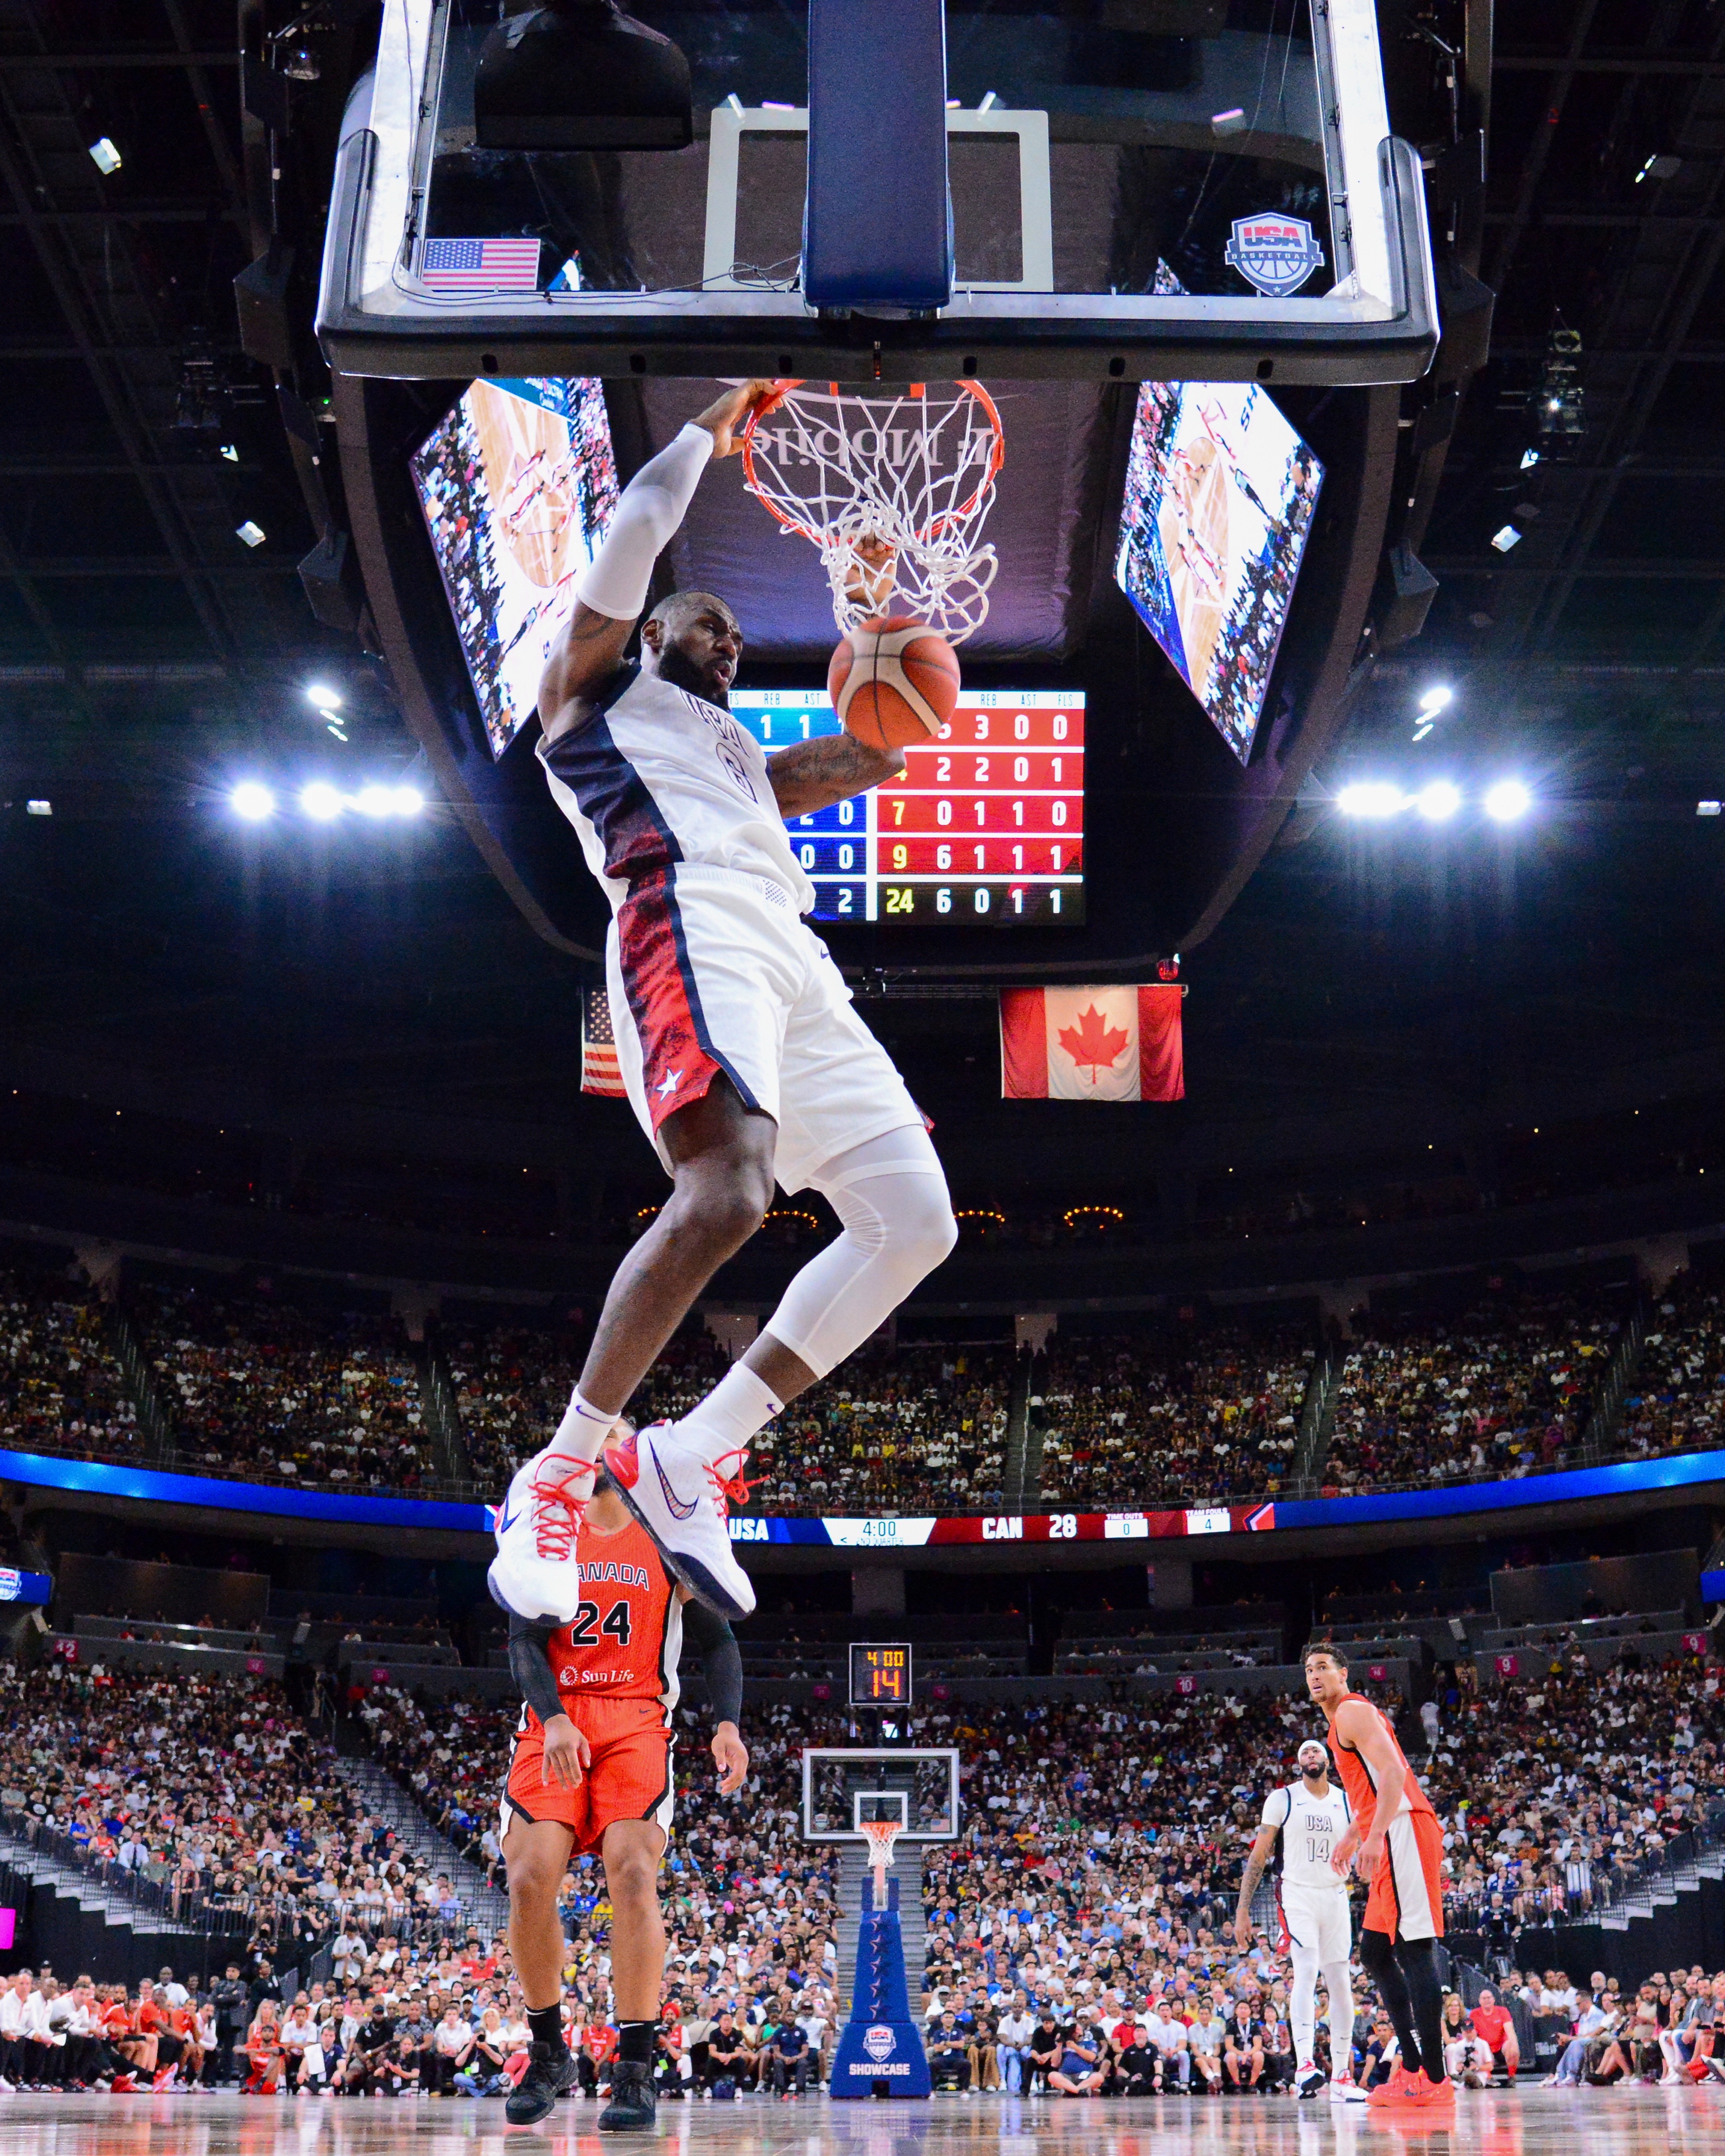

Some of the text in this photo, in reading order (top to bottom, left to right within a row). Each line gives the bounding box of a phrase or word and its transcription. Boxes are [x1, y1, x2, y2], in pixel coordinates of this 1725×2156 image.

[1243, 226, 1303, 248] USA
[1231, 253, 1316, 261] BASKETBALL
[730, 693, 820, 705] TS REB AST
[981, 694, 1072, 706] REB AST FLS
[679, 686, 750, 758] USA
[761, 714, 771, 739] 1
[799, 714, 810, 739] 1
[975, 715, 989, 740] 3
[1014, 715, 1029, 740] 0
[1053, 715, 1068, 740] 0
[716, 742, 759, 804] 6
[937, 757, 951, 782] 2
[975, 757, 989, 782] 2
[1014, 757, 1029, 782] 0
[1052, 757, 1062, 782] 1
[839, 800, 853, 825] 0
[893, 801, 1066, 826] 7 0 1 1 0
[801, 844, 853, 870] 0 0
[893, 844, 1061, 870] 9 6 1 1 1
[838, 889, 852, 913] 2
[886, 889, 1061, 914] 24 6 0 1 1
[730, 1519, 769, 1540] USA
[863, 1521, 896, 1536] 4:00
[982, 1517, 1022, 1539] CAN
[1049, 1514, 1077, 1538] 28
[1123, 1524, 1130, 1535] 0
[1205, 1519, 1212, 1530] 4
[577, 1562, 650, 1591] ANADA
[572, 1600, 632, 1646] 24
[581, 1669, 634, 1683] Sun Life
[873, 1669, 900, 1698] 14
[1305, 1815, 1333, 1832] USA
[1307, 1838, 1329, 1862] 14
[849, 2063, 911, 2075] SHOWCASE
